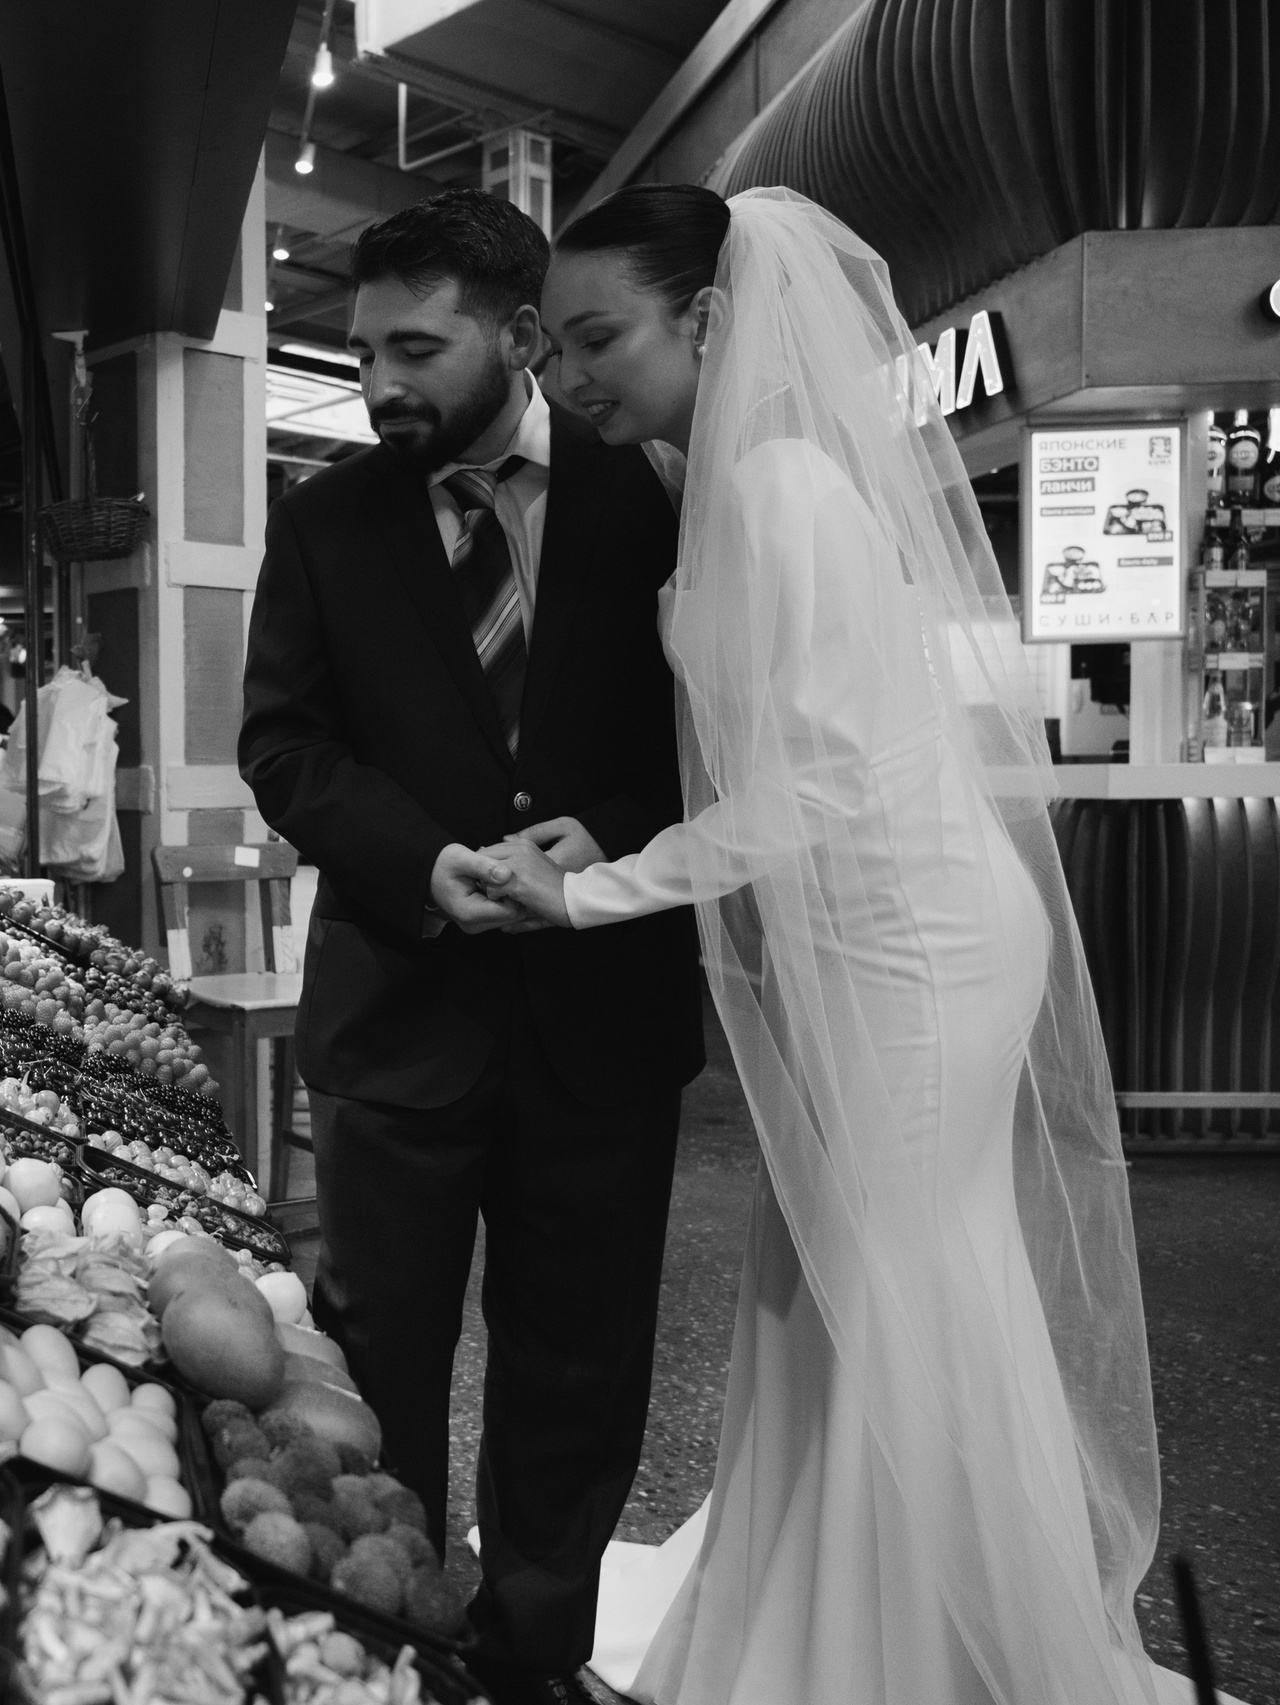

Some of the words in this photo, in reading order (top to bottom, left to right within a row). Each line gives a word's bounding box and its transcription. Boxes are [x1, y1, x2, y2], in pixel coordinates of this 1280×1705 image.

[1038, 437, 1127, 451] ЯПОНСКИЕ
[1040, 457, 1098, 472] БЭНТО
[1039, 613, 1110, 627] СУШИ
